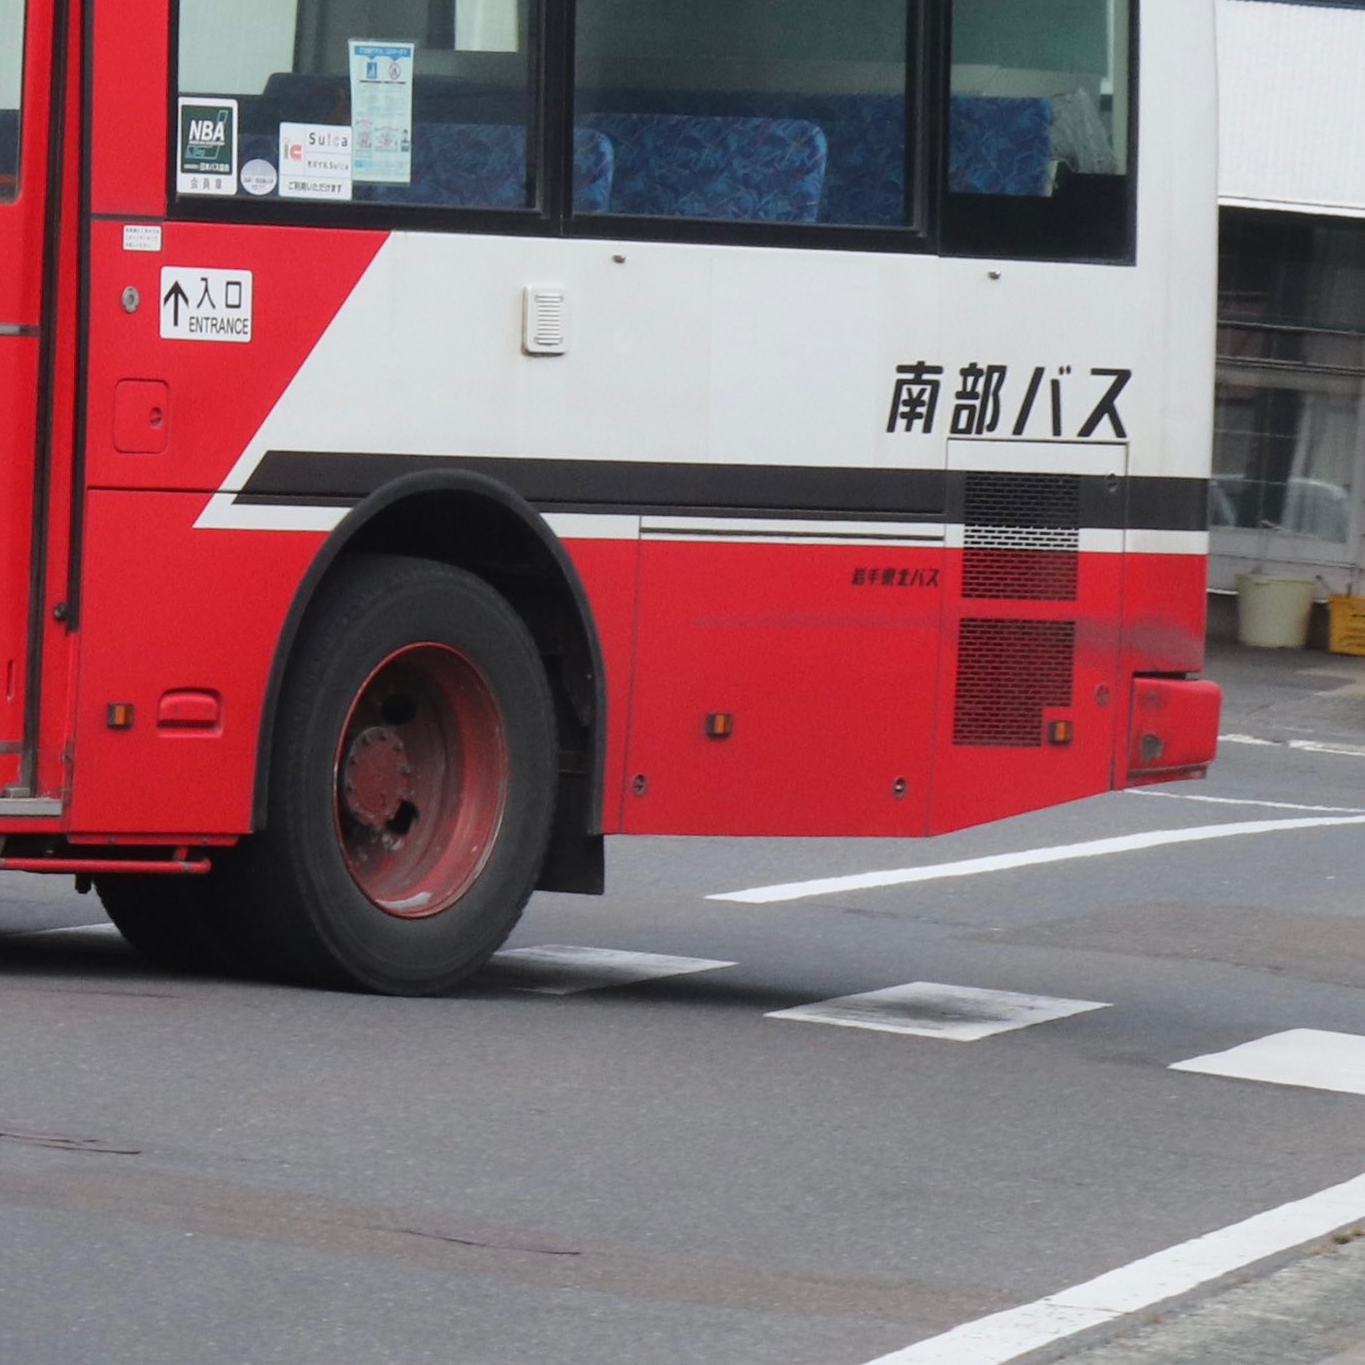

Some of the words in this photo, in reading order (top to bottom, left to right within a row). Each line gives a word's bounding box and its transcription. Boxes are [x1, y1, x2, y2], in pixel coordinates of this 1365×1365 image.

[189, 120, 225, 142] NBA
[309, 132, 348, 148] Suica
[288, 181, 343, 194] ご利用いただけます
[196, 277, 242, 310] 入口
[188, 316, 249, 335] ENTRANCE
[886, 361, 1132, 438] 南部バス
